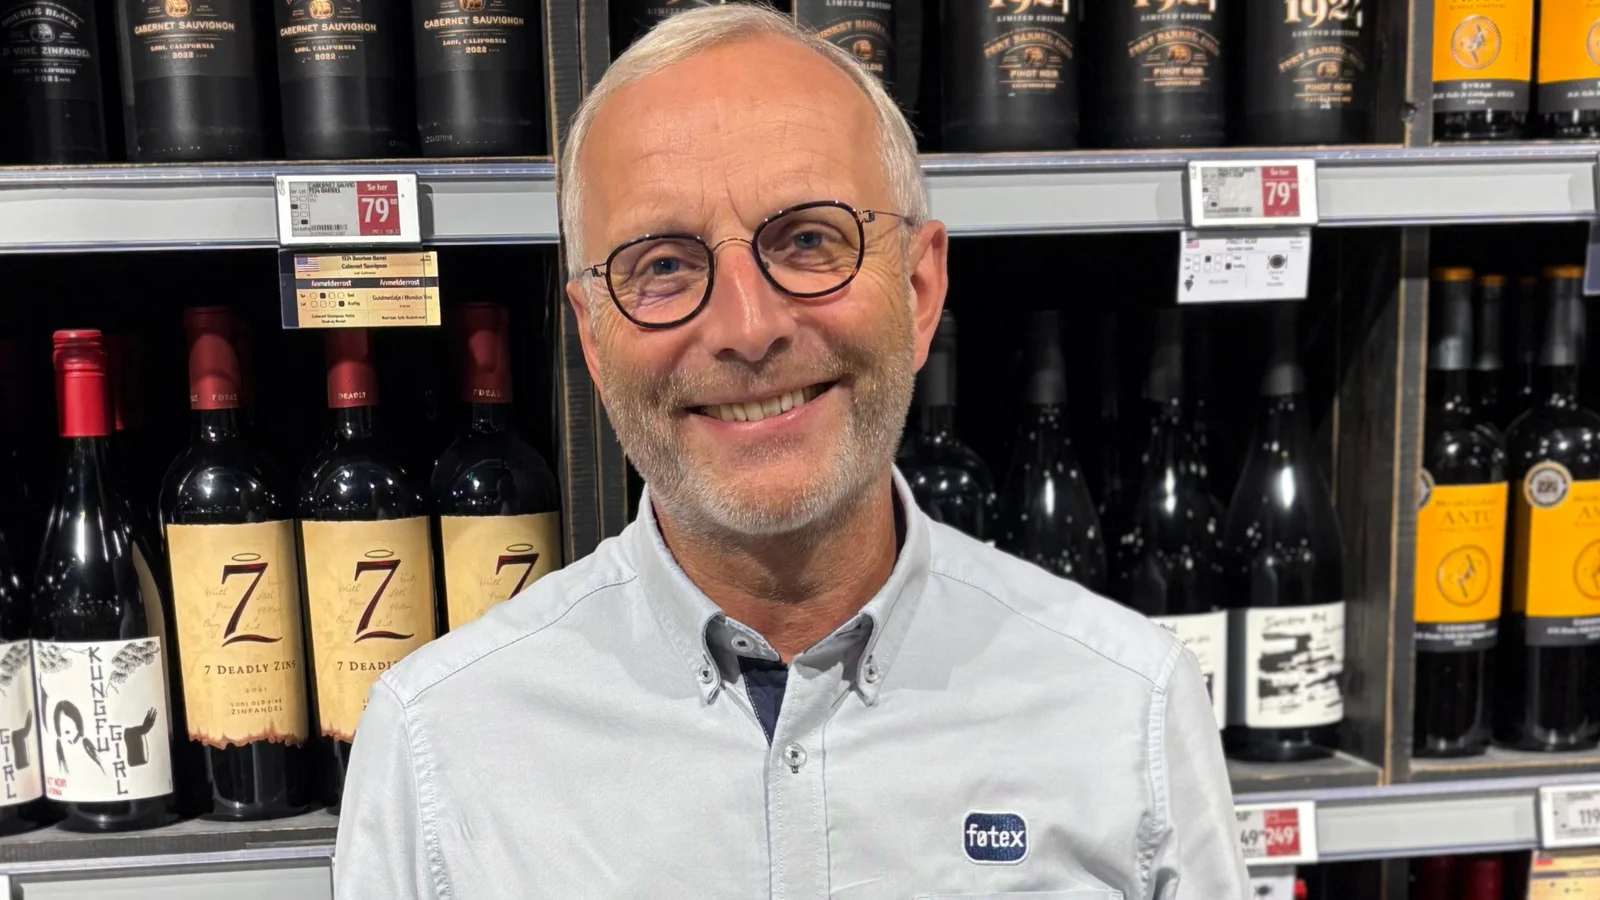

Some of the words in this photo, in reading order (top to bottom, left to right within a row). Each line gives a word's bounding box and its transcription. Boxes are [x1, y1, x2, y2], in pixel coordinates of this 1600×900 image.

[45, 8, 78, 28] BLACK
[424, 16, 469, 29] CABERNET
[472, 15, 524, 26] SAUVIGNON
[996, 14, 1034, 23] LIMITED
[1036, 14, 1067, 23] EDITION
[1140, 13, 1178, 22] LIMITED
[1180, 12, 1212, 21] EDITION
[134, 21, 176, 35] CABERNET
[178, 20, 236, 33] SAUVIGNON
[280, 23, 319, 37] CABERNET
[321, 22, 377, 33] SAUVIGNON
[1331, 29, 1361, 37] EDITION
[169, 42, 214, 50] CALIFORNIA
[463, 37, 507, 45] CALIFORNIA
[13, 46, 38, 55] VINE
[41, 46, 91, 58] ZINFANDEL
[312, 44, 357, 52] CALIFORNIA
[465, 46, 487, 54] 2022
[1010, 69, 1038, 79] PINOT
[1039, 69, 1061, 80] NOIR
[1153, 67, 1181, 77] PINOT
[1183, 67, 1205, 77] NOIR
[366, 183, 376, 191] Se
[377, 183, 388, 191] her
[1265, 181, 1290, 206] 79
[361, 197, 389, 223] 79
[311, 279, 352, 287] Anmelderrost
[380, 278, 420, 286] Anmelderrost
[205, 665, 210, 675] 7
[218, 664, 268, 675] DEADLY
[274, 659, 296, 671] ZINS
[337, 661, 343, 671] 7
[231, 706, 283, 715] ZINFANDEL
[108, 724, 129, 795] GIRL
[966, 823, 1025, 848] føtex
